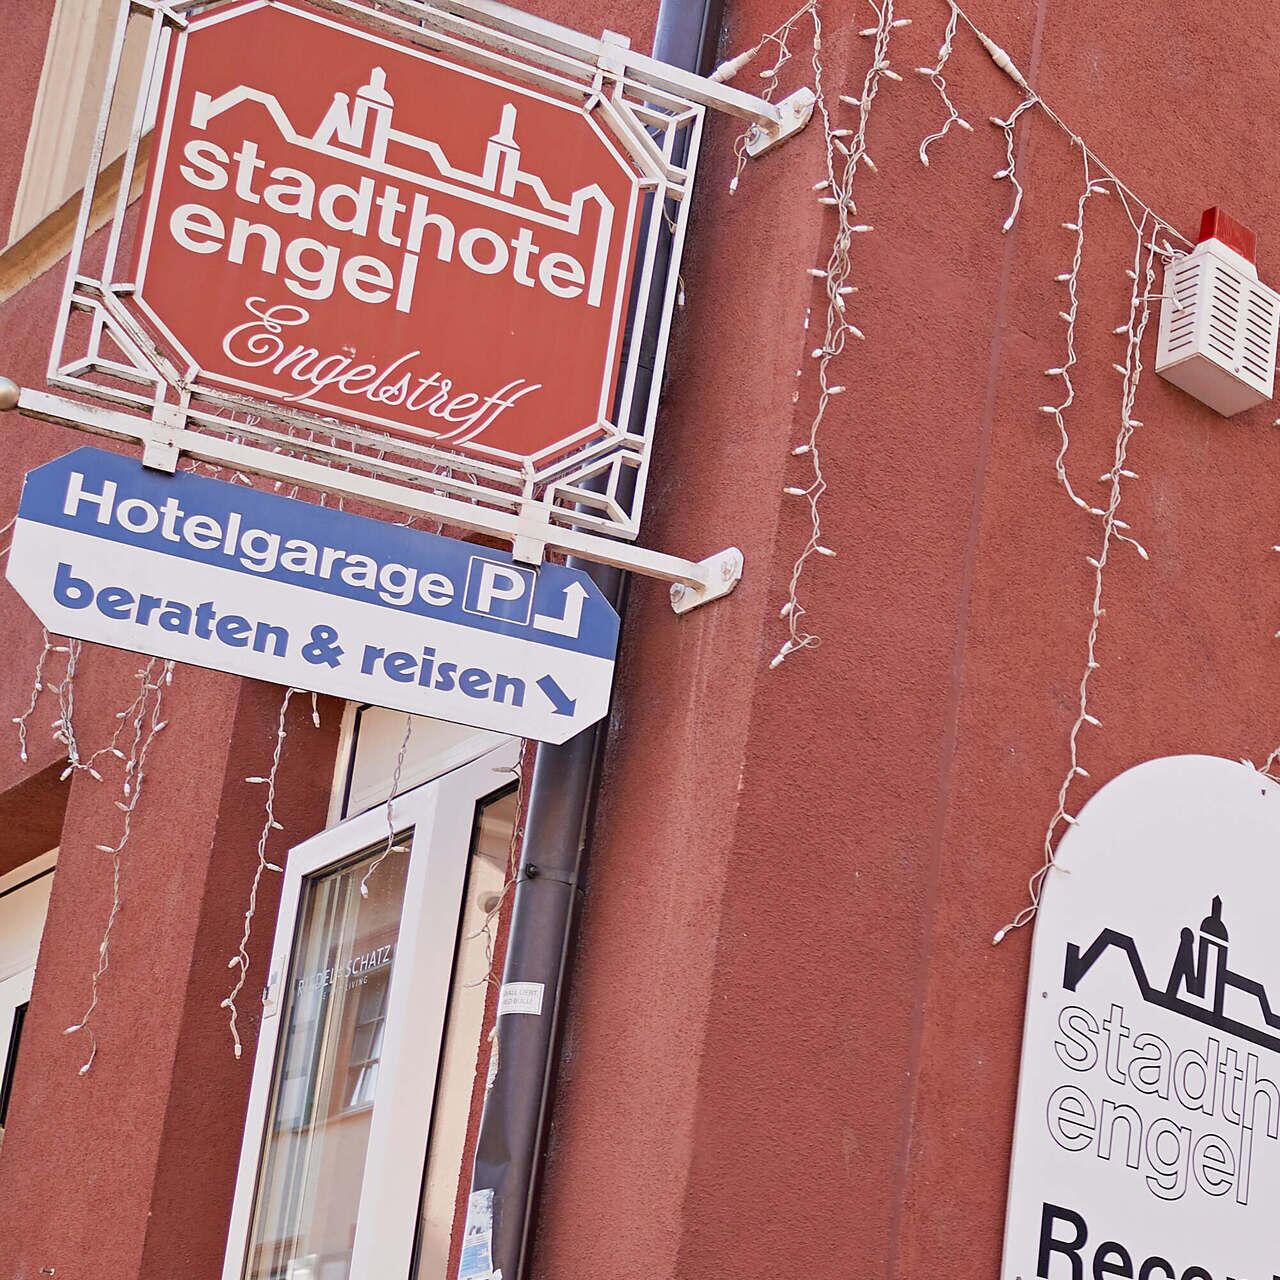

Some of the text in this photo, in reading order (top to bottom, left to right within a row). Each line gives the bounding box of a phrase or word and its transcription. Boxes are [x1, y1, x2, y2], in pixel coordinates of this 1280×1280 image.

[170, 203, 417, 312] engel
[179, 138, 608, 306] stadthotel
[222, 296, 544, 444] Engelstreff
[63, 471, 529, 614] Hotelgarage P
[53, 563, 525, 707] beraten & reisen
[345, 944, 391, 977] SCHATZ
[1046, 1083, 1252, 1206] engel
